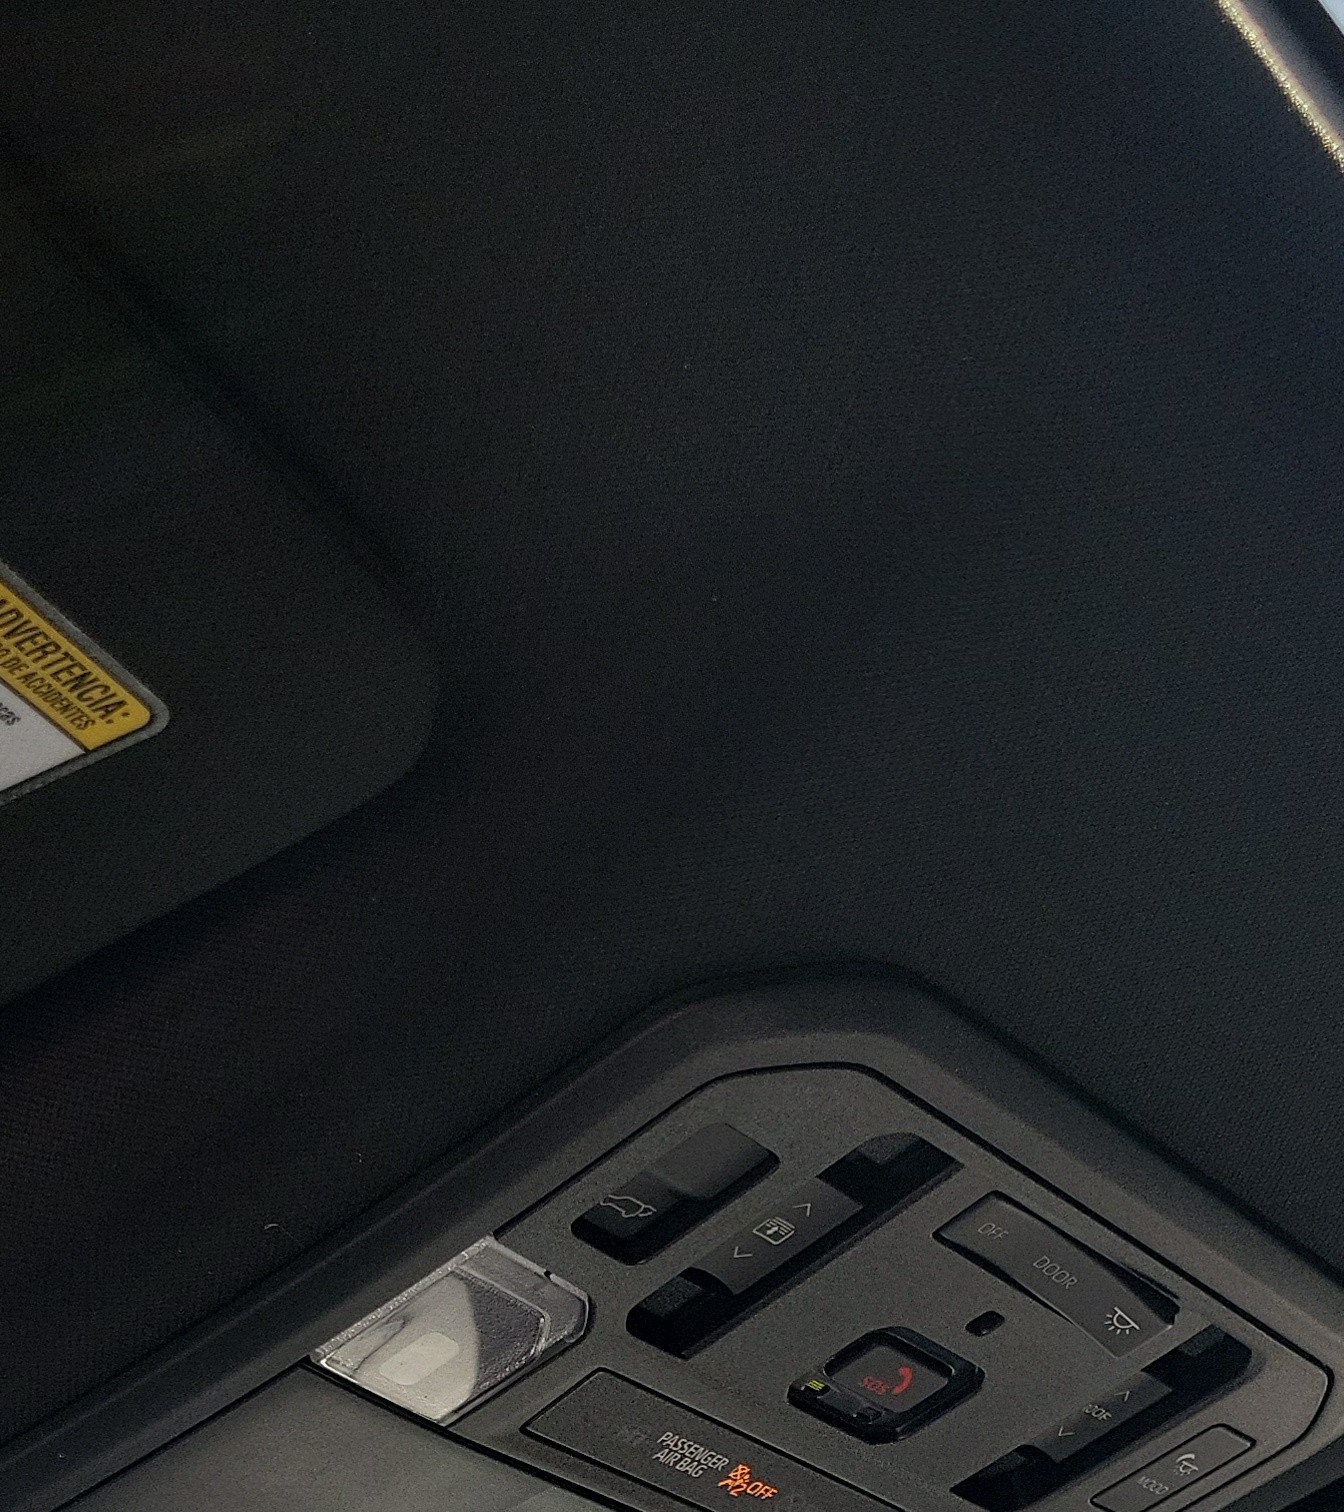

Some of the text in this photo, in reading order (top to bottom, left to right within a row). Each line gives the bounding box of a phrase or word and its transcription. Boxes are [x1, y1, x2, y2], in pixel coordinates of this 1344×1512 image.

[13, 670, 101, 731] ACCIDENTES
[978, 1222, 1008, 1240] OFF
[1033, 1255, 1078, 1289] DOOR
[652, 1449, 708, 1478] AIR BAG
[657, 1432, 729, 1471] PASSENGER
[747, 1481, 778, 1499] OFF
